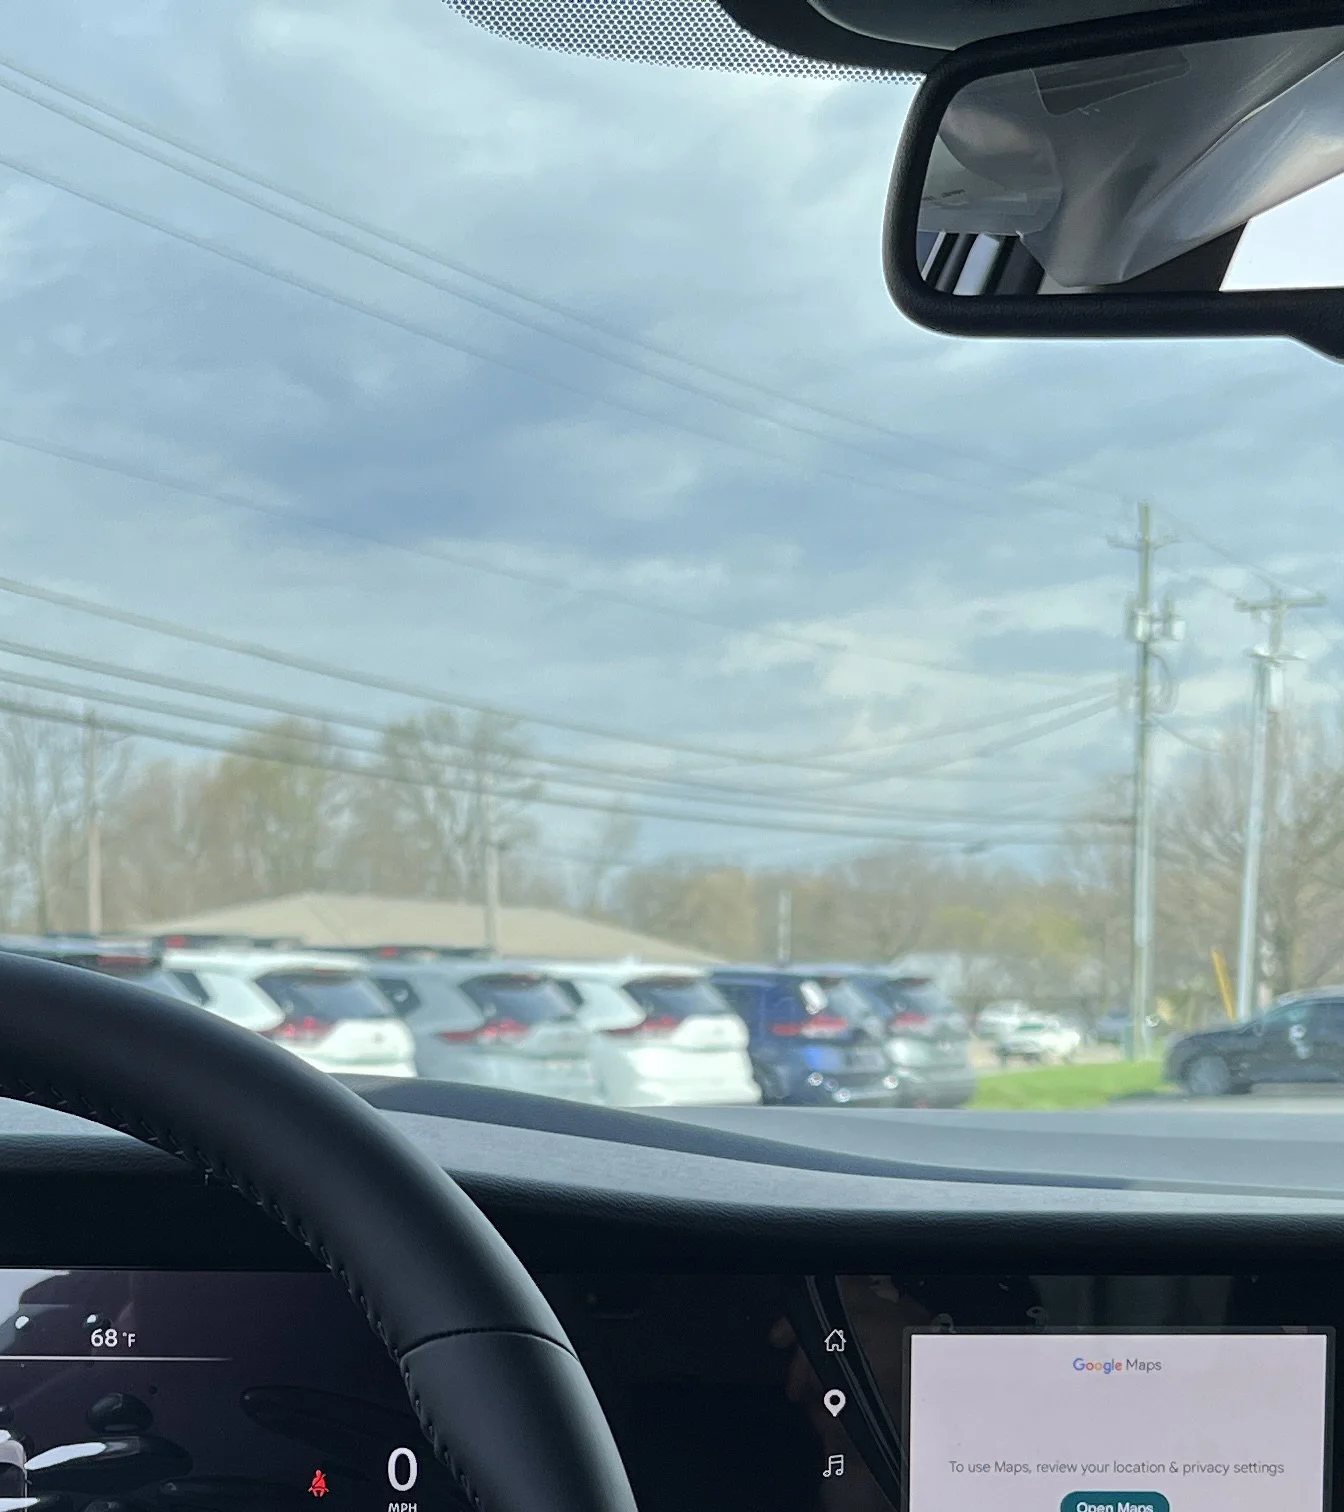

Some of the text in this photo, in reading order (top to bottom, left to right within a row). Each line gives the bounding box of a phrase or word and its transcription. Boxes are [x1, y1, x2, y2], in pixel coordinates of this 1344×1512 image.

[91, 1328, 118, 1347] 68
[1072, 1357, 1162, 1374] Google Maps
[387, 1447, 417, 1491] 0
[949, 1460, 1285, 1476] To use Maps, review your location & privacy settings
